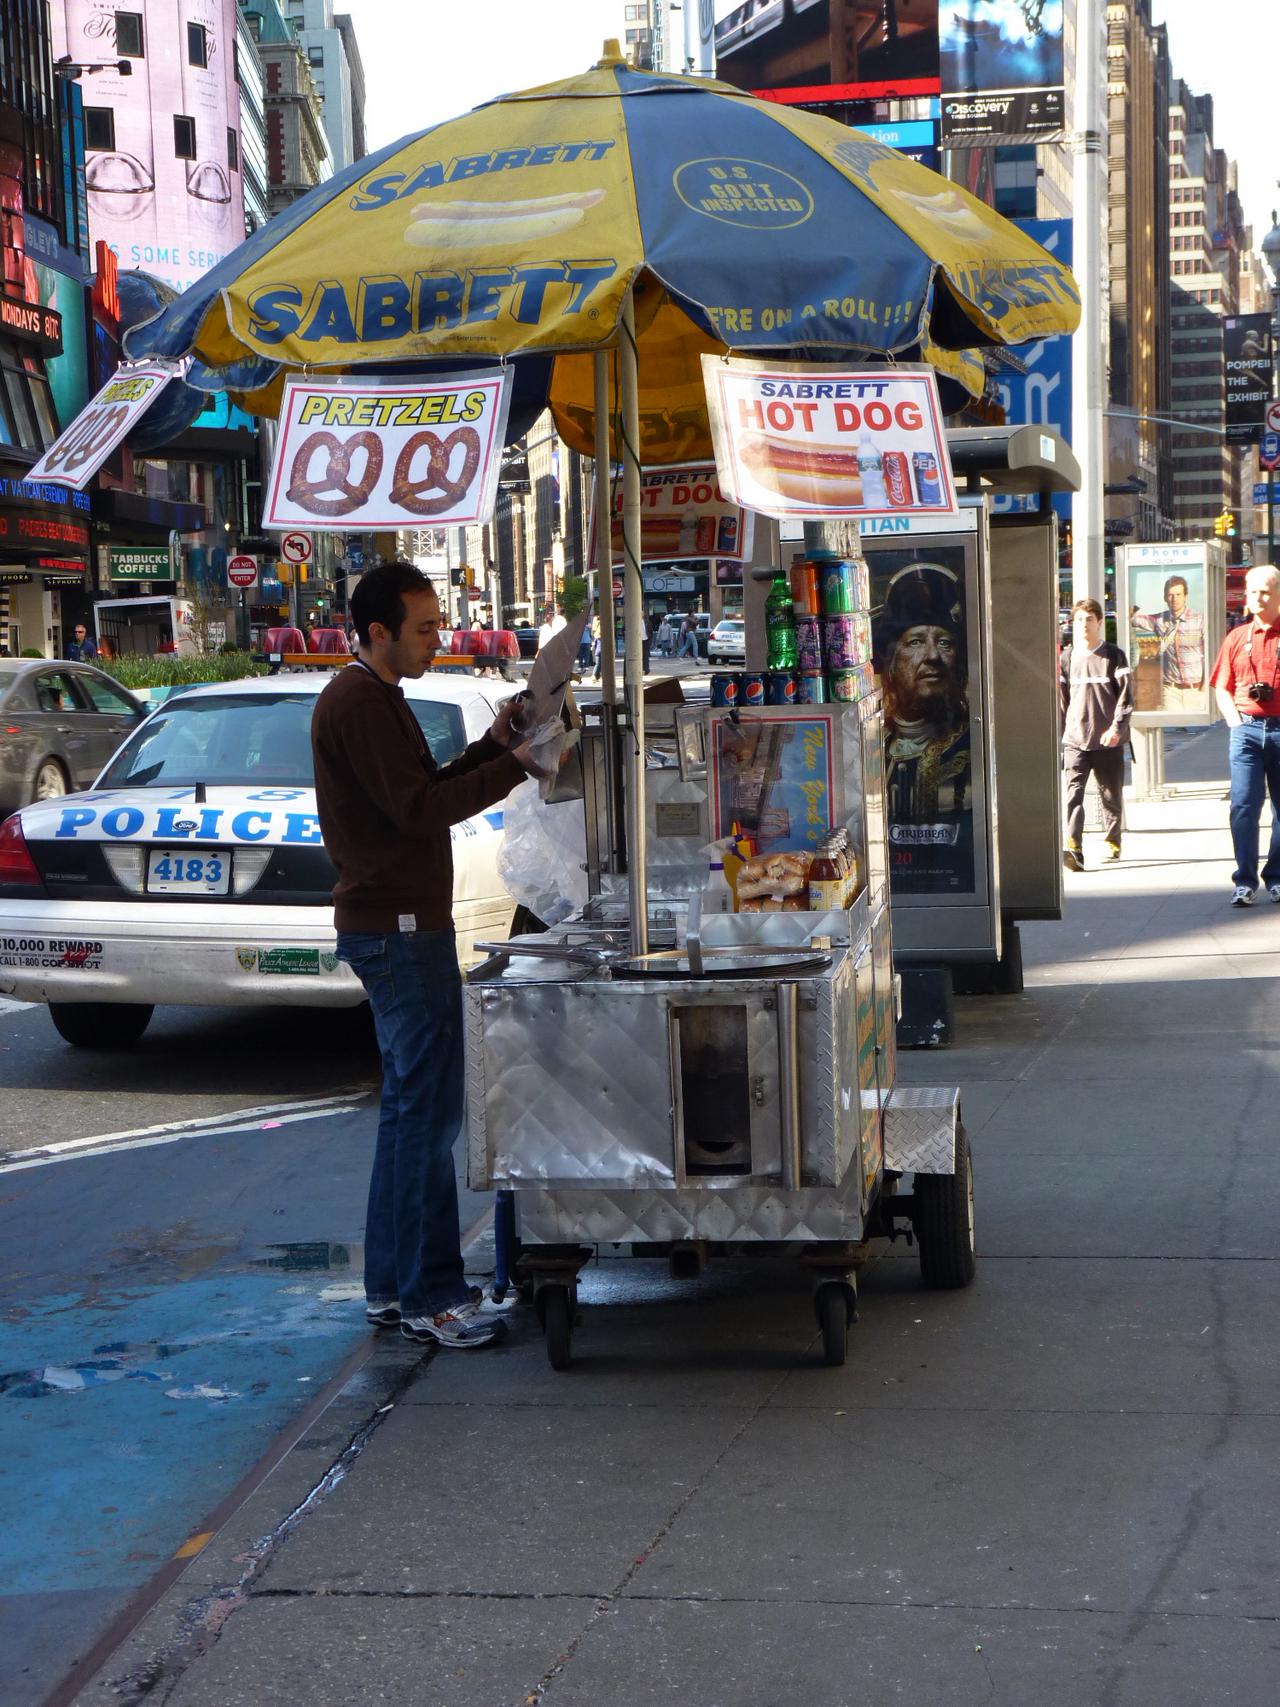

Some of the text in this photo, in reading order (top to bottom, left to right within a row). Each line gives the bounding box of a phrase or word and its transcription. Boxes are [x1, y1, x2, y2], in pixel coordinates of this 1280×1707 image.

[946, 101, 1010, 115] Discovery
[349, 139, 616, 212] SABRETT
[707, 166, 752, 180] U.S.
[709, 183, 775, 199] GOV'T
[700, 198, 804, 212] INSPECTED
[131, 244, 181, 265] SOME
[247, 258, 618, 345] SABRETT
[760, 308, 792, 332] ON
[801, 304, 817, 320] A
[822, 297, 878, 324] ROLL
[1226, 359, 1271, 371] POMPEII
[1226, 376, 1249, 387] THE
[760, 382, 890, 399] SABRETT
[1227, 391, 1270, 403] EXHIBIT
[298, 391, 486, 427] PRETZELS
[739, 398, 818, 432] HOT
[833, 401, 924, 432] DOG
[110, 554, 169, 564] TARBUCKS
[1142, 547, 1190, 557] Phone
[117, 564, 158, 574] COFFEE
[644, 577, 687, 592] LOFT
[55, 806, 324, 844] POLICE
[154, 859, 222, 883] 4183
[49, 940, 103, 954] REWARD
[19, 957, 40, 967] 1-800
